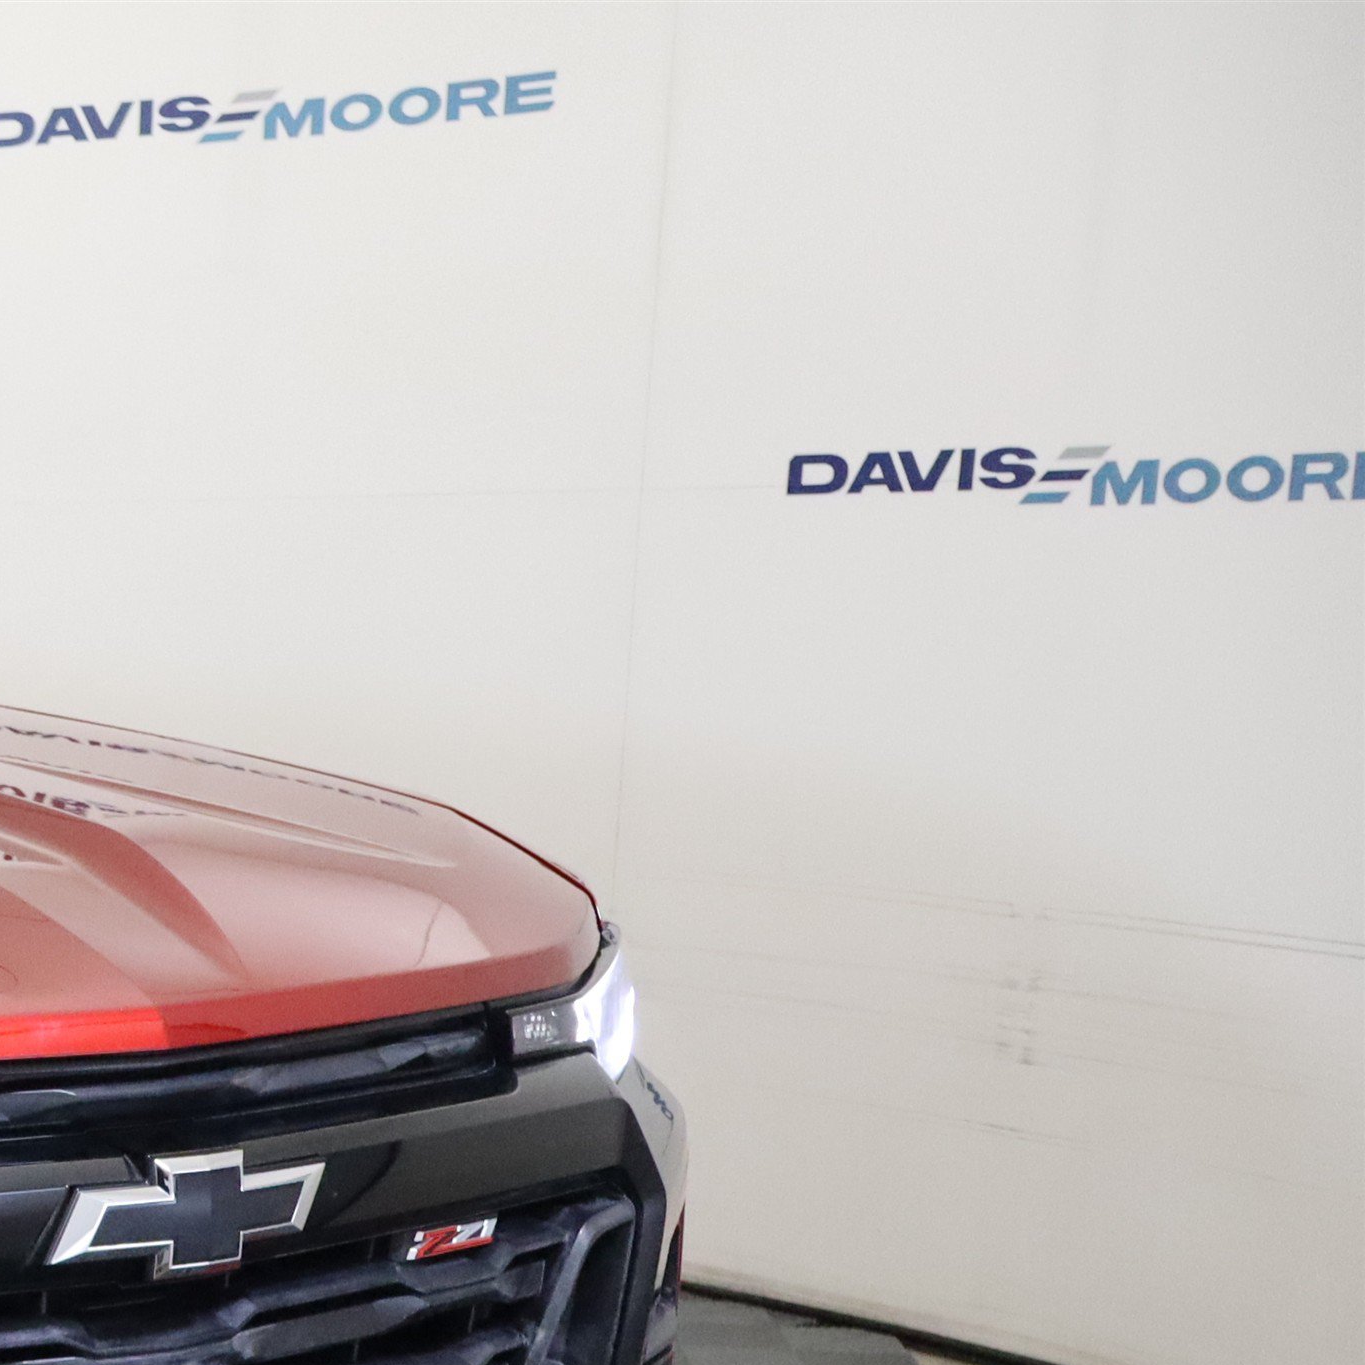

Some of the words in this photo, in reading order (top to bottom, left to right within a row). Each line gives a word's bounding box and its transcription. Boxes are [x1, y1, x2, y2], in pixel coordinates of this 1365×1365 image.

[262, 70, 557, 140] MOORE
[786, 447, 1038, 495] DAVIS
[1089, 450, 1365, 506] MOOR
[406, 1217, 498, 1261] Z71
